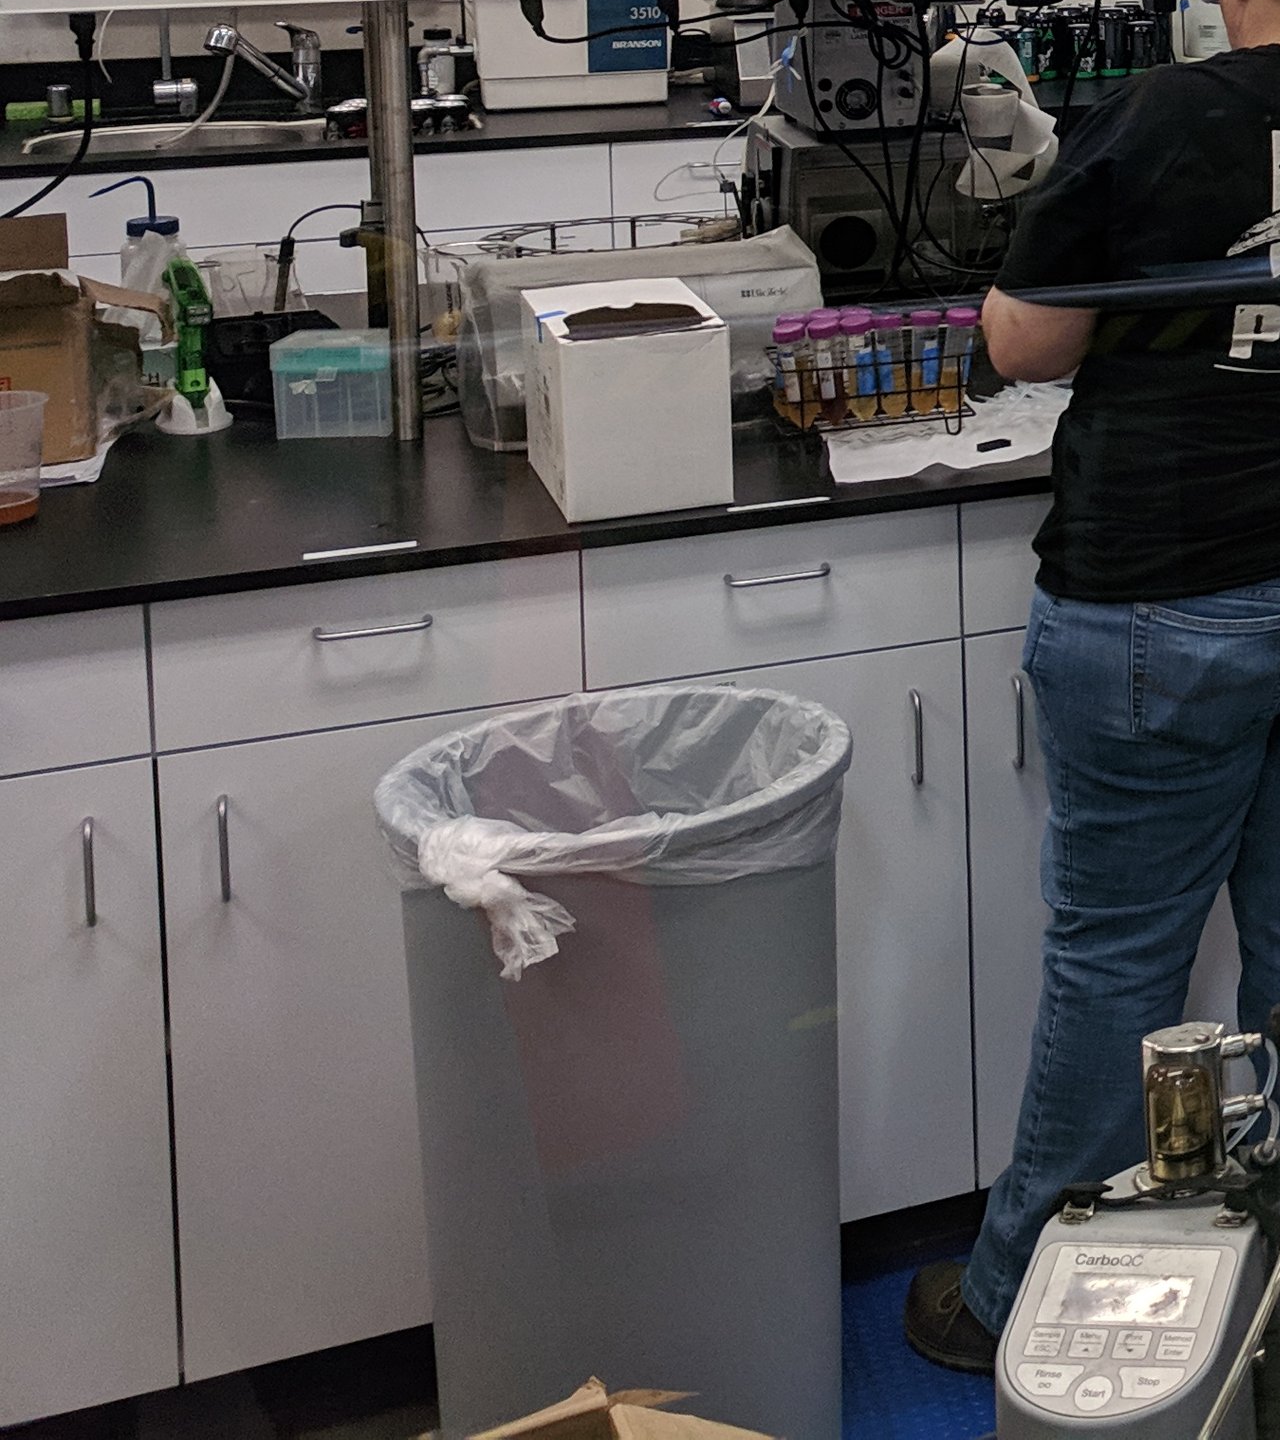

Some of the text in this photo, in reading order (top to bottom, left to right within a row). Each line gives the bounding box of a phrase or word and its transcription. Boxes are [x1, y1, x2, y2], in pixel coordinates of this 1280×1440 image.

[630, 6, 661, 20] 3510
[612, 39, 662, 49] BRANSON
[1075, 1253, 1144, 1267] CarboQC
[1033, 1330, 1061, 1339] Sample
[1163, 1334, 1192, 1343] Method
[1163, 1348, 1183, 1357] Enter
[1035, 1369, 1062, 1379] Rinse
[1137, 1377, 1160, 1387] Stop
[1081, 1388, 1106, 1399] Start
